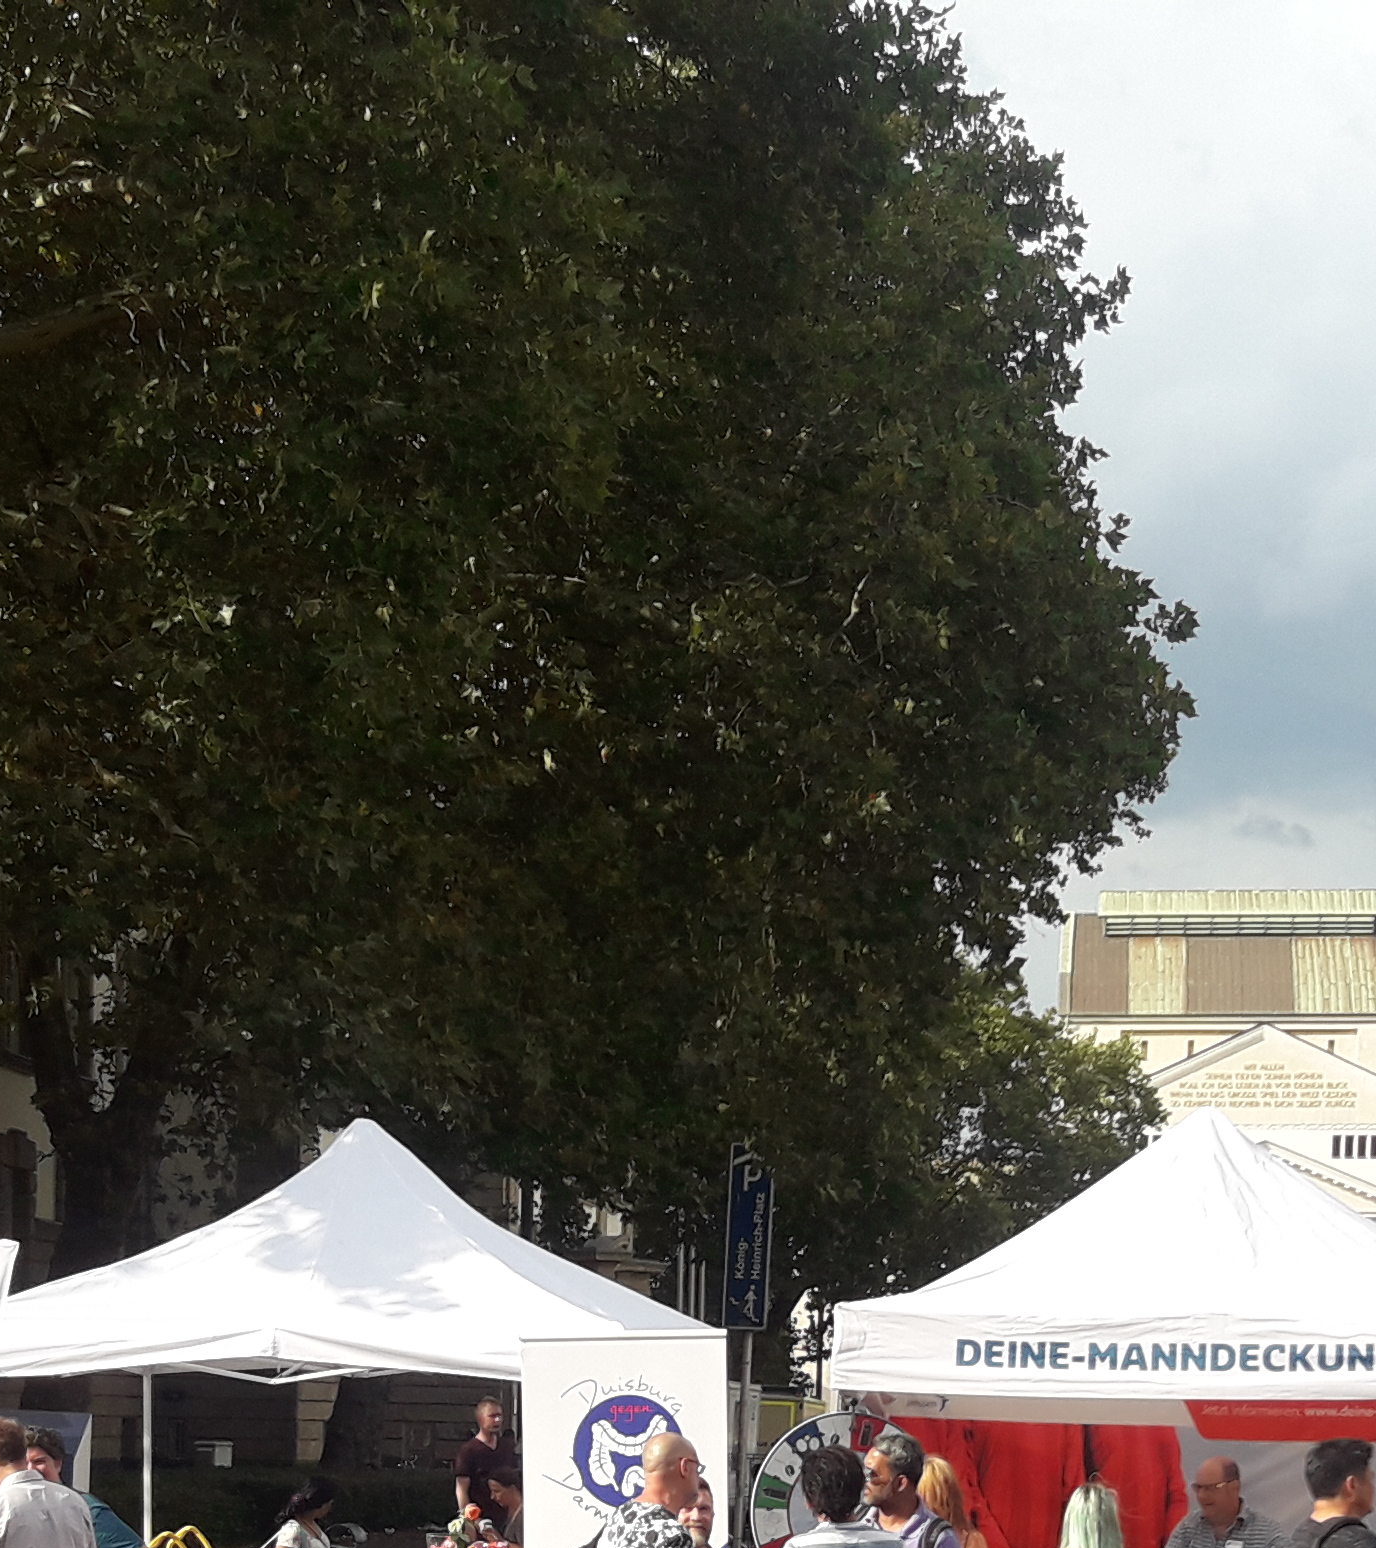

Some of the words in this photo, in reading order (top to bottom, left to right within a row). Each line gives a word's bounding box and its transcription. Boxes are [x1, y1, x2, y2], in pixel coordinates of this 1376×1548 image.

[734, 1236, 749, 1280] König-
[750, 1192, 766, 1281] Heinrich-Platz
[560, 1374, 683, 1418] Duisburg
[608, 1404, 655, 1423] gegen
